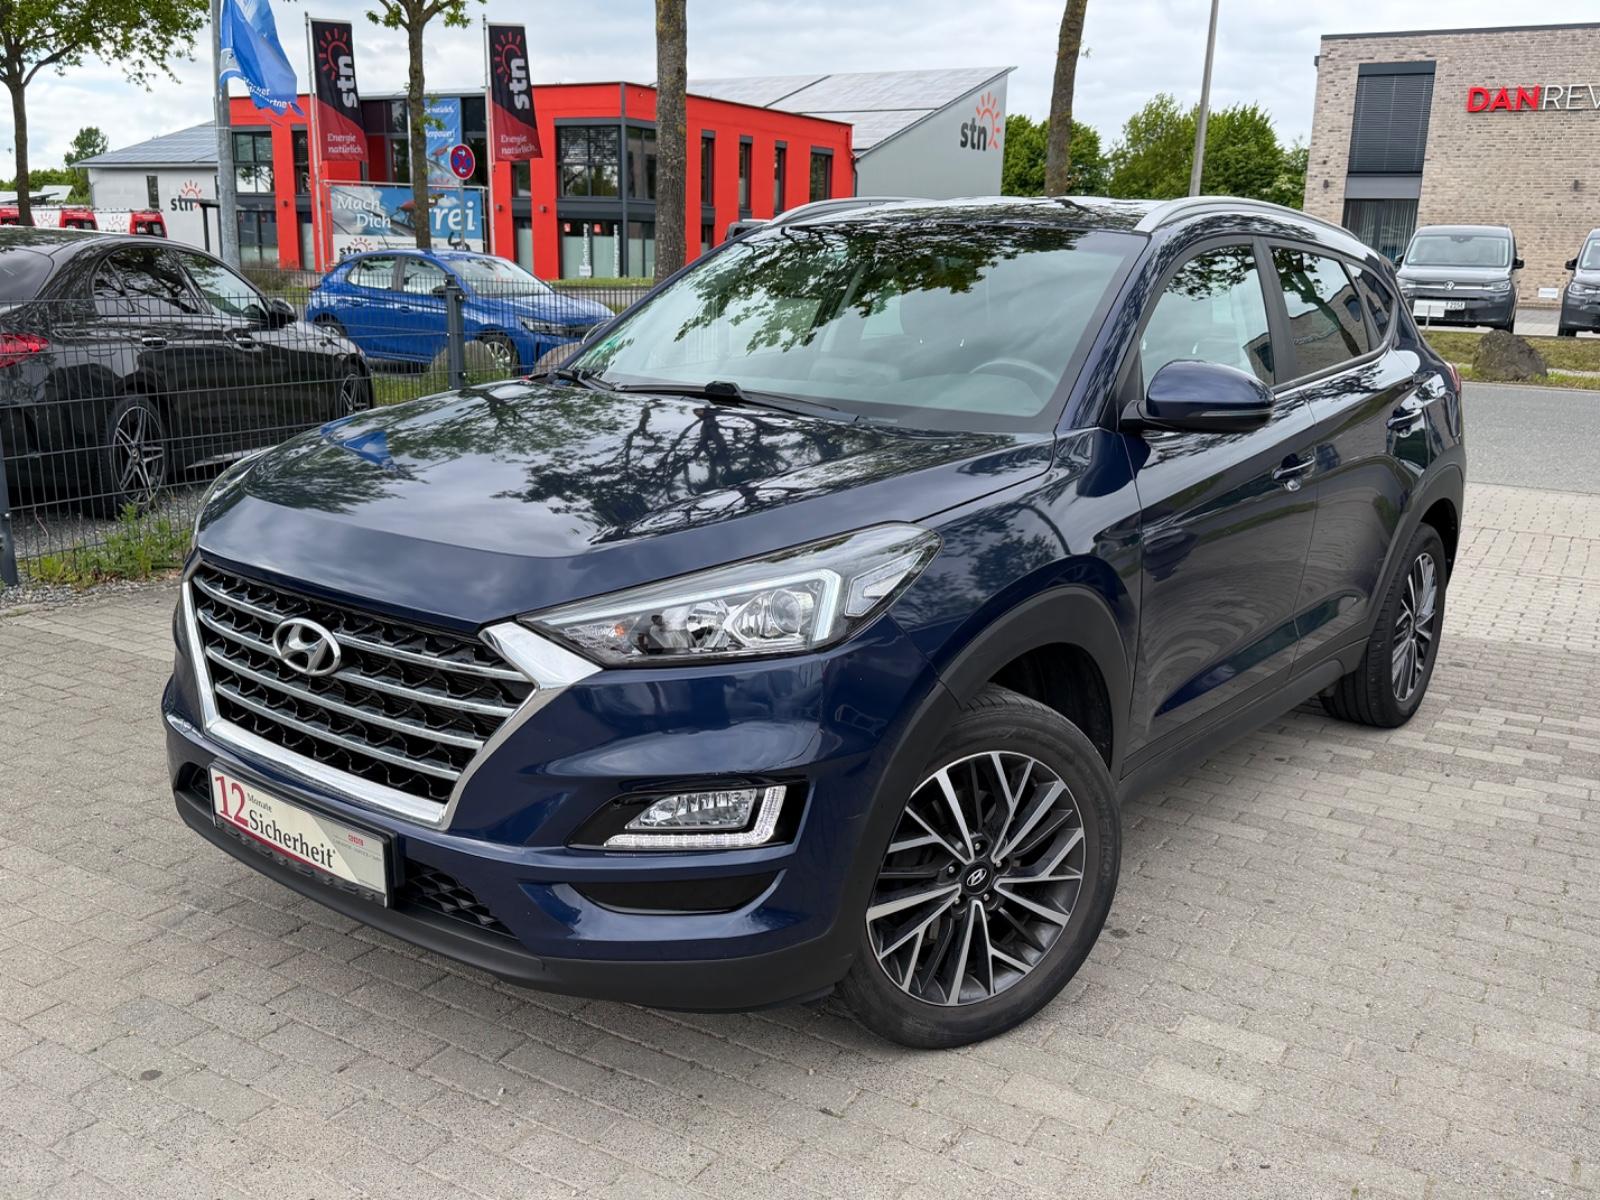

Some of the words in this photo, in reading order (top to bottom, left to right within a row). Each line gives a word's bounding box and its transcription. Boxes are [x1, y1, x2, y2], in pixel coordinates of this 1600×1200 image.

[336, 55, 358, 108] stn
[508, 58, 530, 110] stn
[328, 133, 356, 144] Energie
[500, 134, 527, 145] Energie
[960, 117, 987, 152] stn
[170, 195, 194, 212] stn
[336, 195, 381, 210] Mach
[356, 213, 391, 229] Dich
[429, 201, 476, 231] rei
[215, 775, 249, 828] 12
